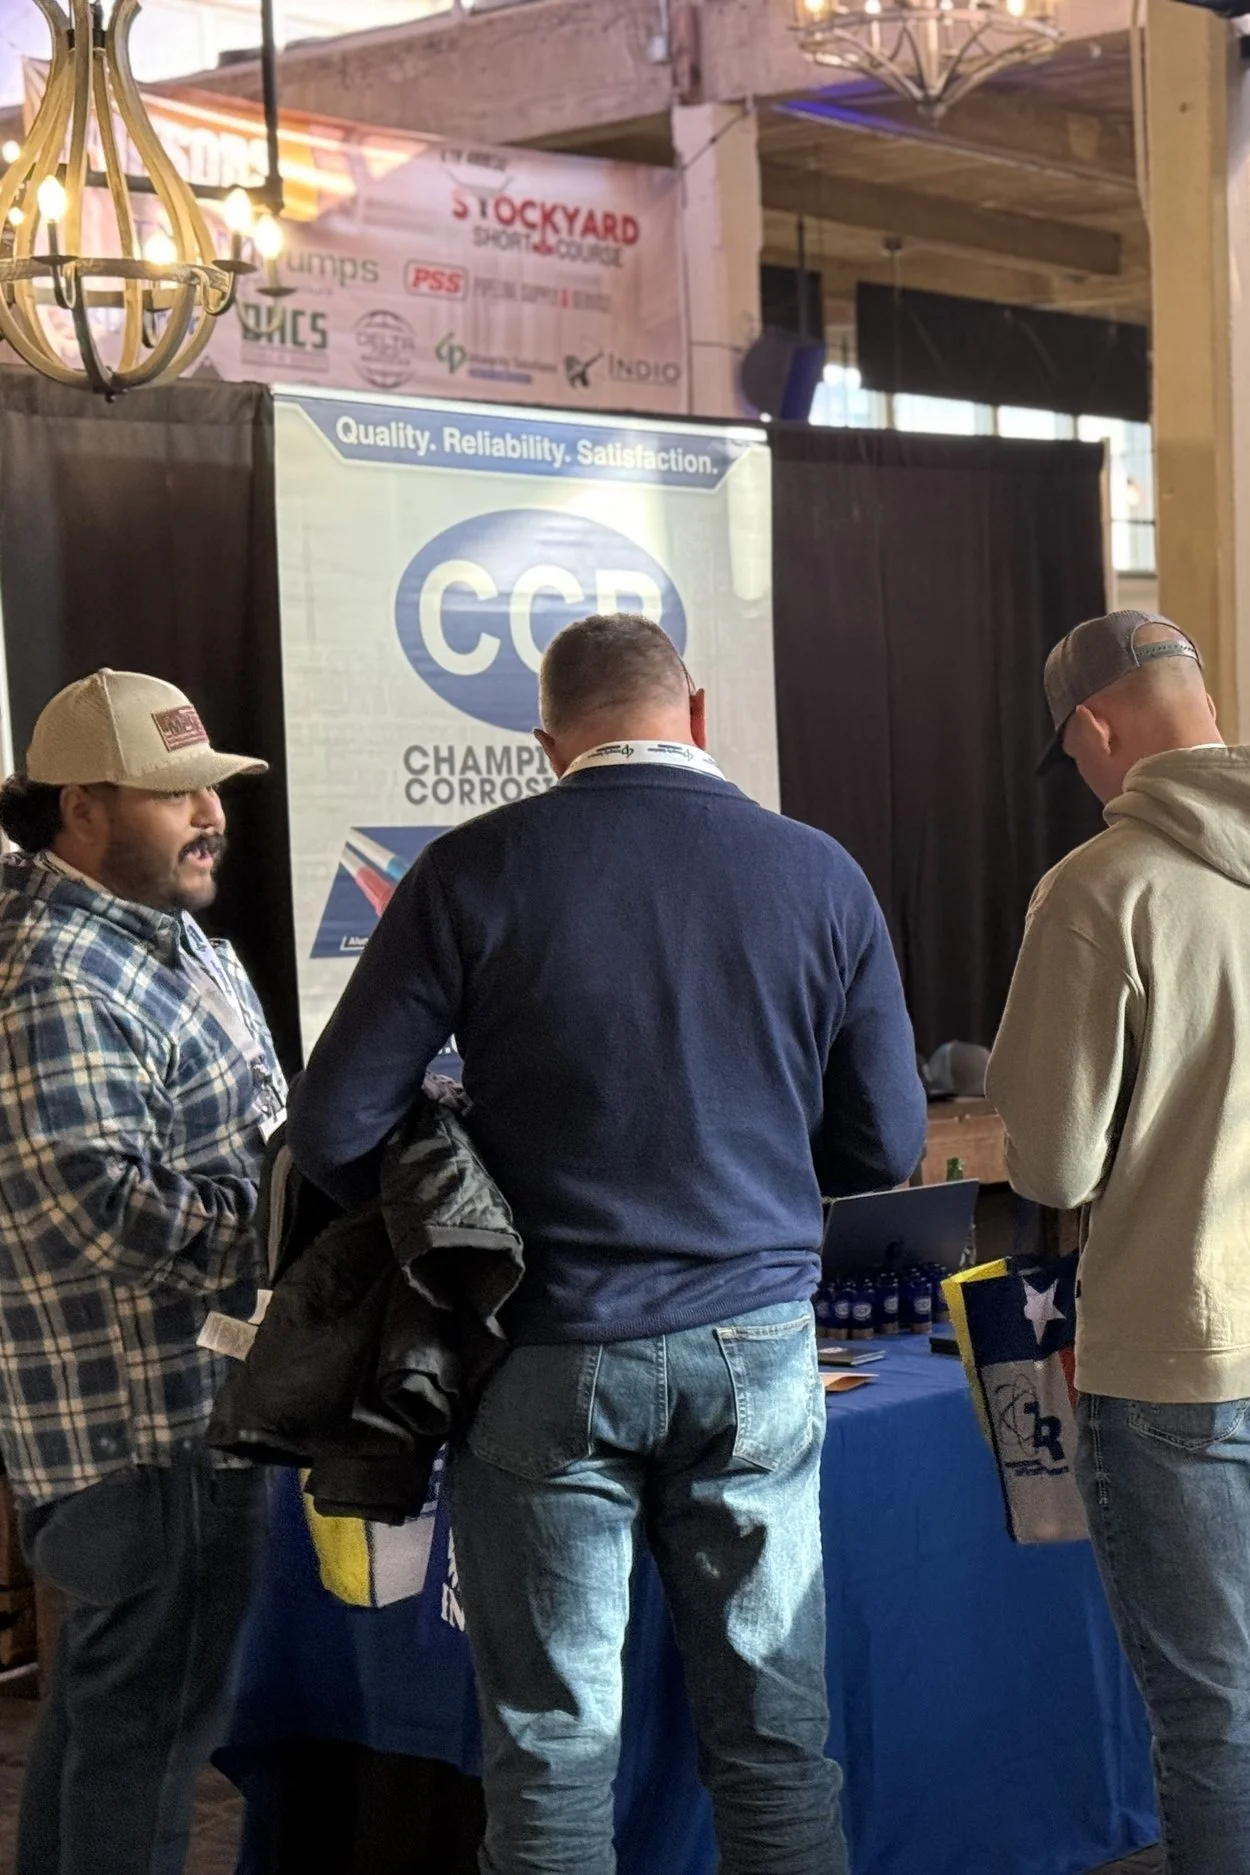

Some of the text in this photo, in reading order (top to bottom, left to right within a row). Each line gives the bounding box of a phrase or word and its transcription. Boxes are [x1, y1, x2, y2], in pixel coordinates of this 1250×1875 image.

[452, 187, 640, 246] STOCKYARD
[473, 226, 623, 268] SHORT COURSE
[284, 251, 380, 287] umps
[411, 267, 463, 294] PSS
[609, 352, 682, 384] INDIO
[335, 415, 719, 476] Quality. Reliability. Satisfaction.
